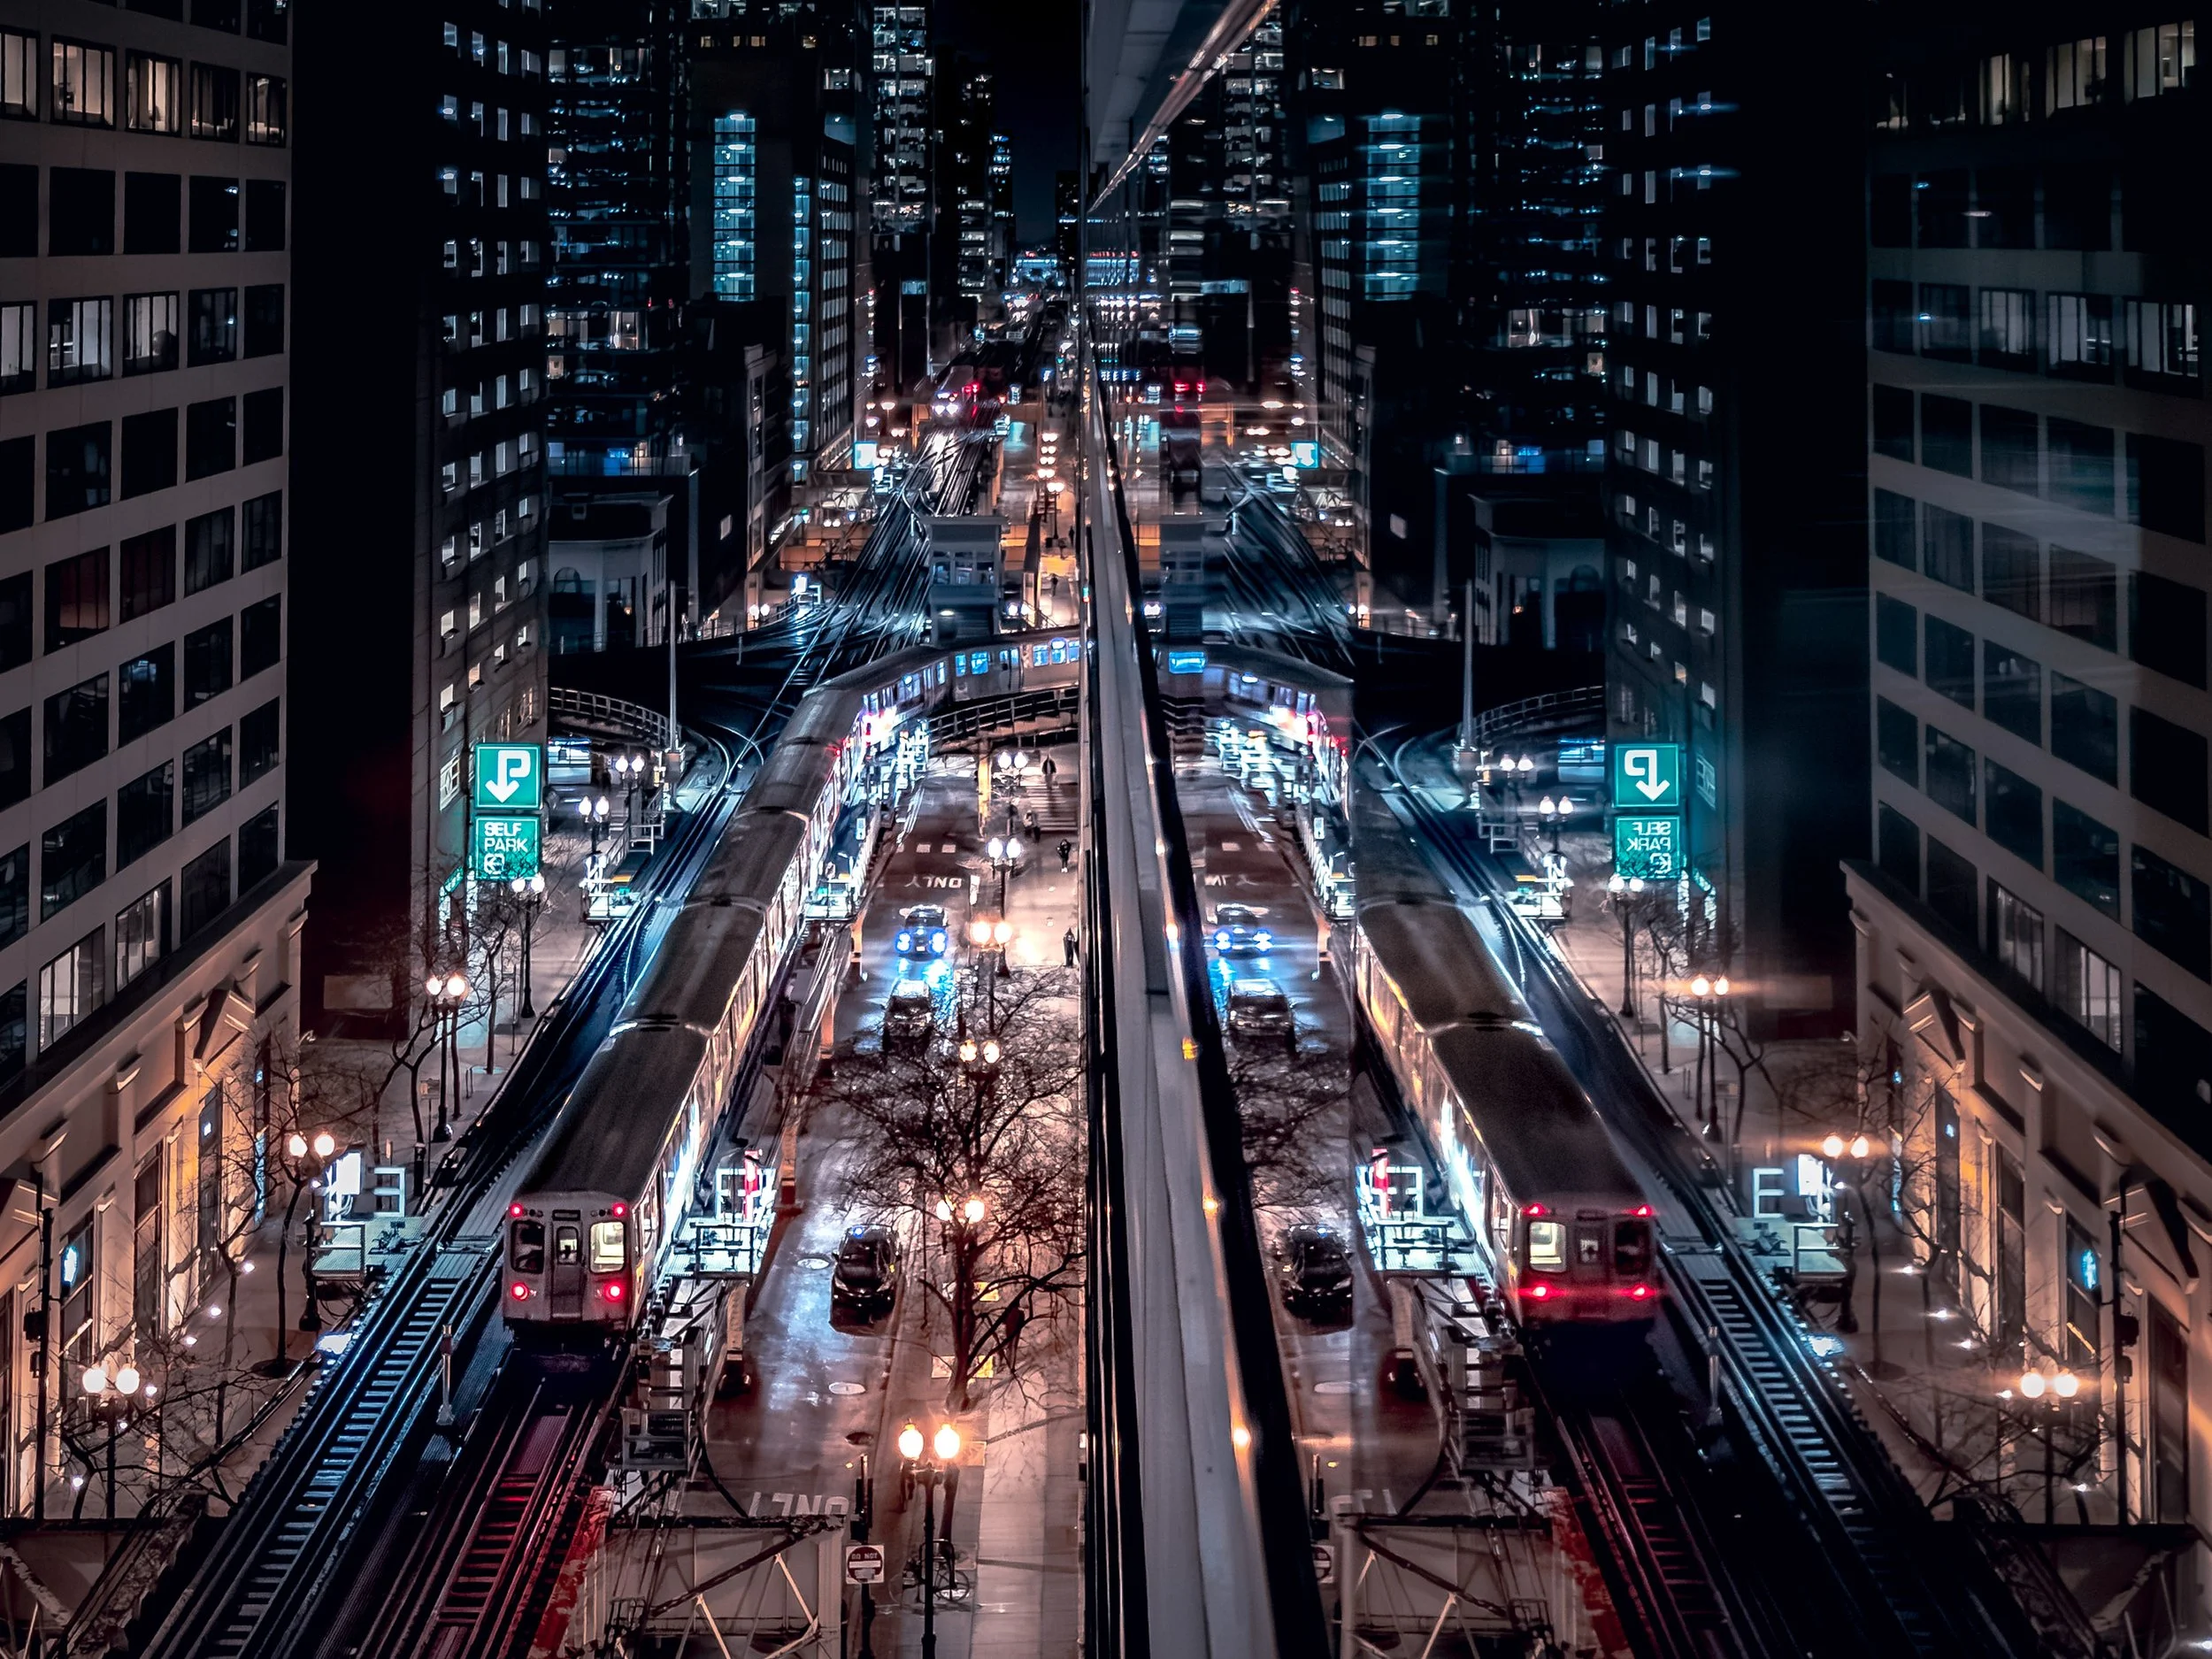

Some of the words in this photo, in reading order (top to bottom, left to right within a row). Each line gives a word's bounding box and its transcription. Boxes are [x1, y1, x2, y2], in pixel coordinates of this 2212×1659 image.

[497, 750, 531, 803] P
[484, 822, 522, 836] SELF
[484, 838, 528, 852] PARK
[904, 875, 963, 888] ONLY
